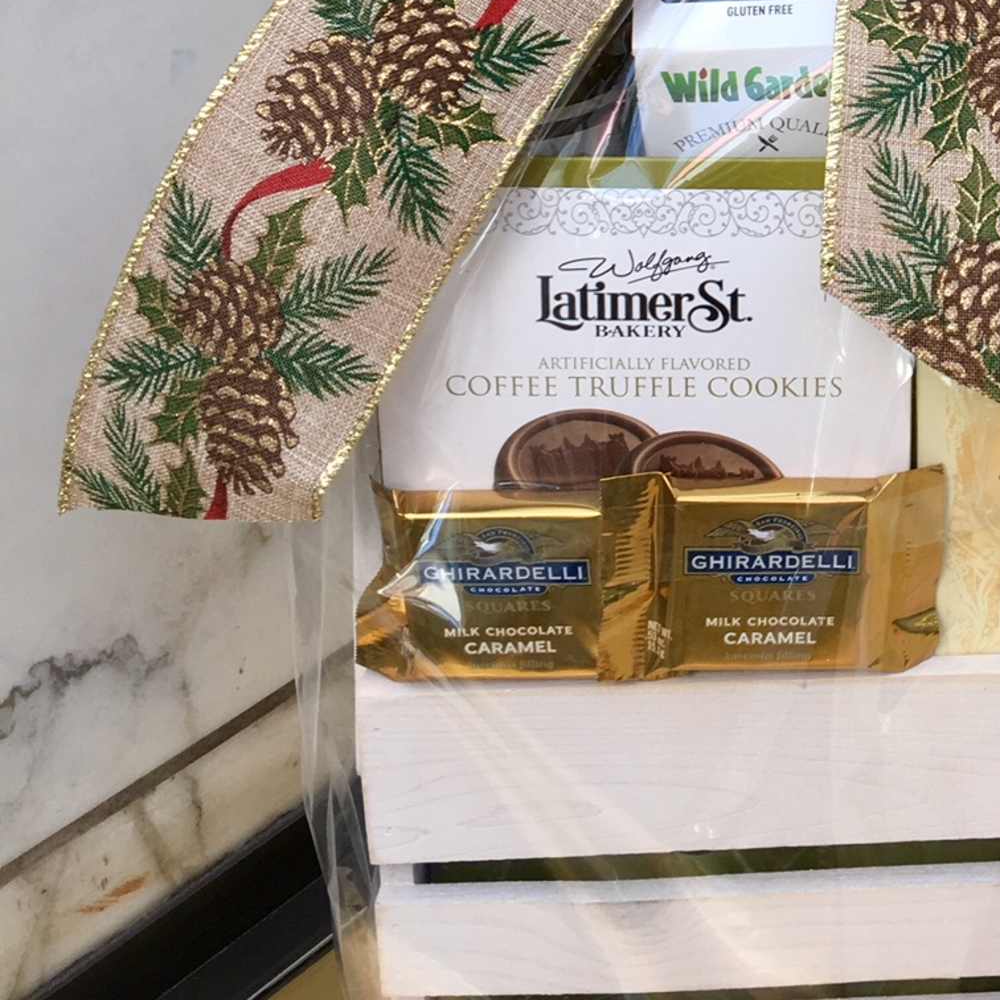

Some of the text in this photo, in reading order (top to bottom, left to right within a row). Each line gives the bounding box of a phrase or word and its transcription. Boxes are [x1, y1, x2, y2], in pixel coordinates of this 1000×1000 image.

[727, 4, 793, 17] GLUTEN FREE
[660, 65, 832, 103] Wild Garde
[673, 116, 764, 153] PREMIUM
[558, 249, 730, 284] Wolfgang
[595, 324, 686, 338] BAKERY
[538, 357, 751, 371] ARTIFICIALLY FLAVORED
[446, 375, 843, 398] COFFEE TRUFFLE COOKIES
[691, 554, 853, 570] GHIRARDELLI
[423, 565, 584, 582] GHIRARDELLI
[736, 575, 809, 583] CHOCOLATE
[469, 585, 541, 594] CHOCOLATE
[729, 589, 816, 603] SQUARES
[464, 600, 552, 613] SQUARES
[705, 616, 835, 627] MILK CHOCOLATE
[444, 625, 574, 638] MILK CHOCOLATE
[723, 631, 817, 645] CARAMEL
[464, 640, 557, 655] CARAMEL
